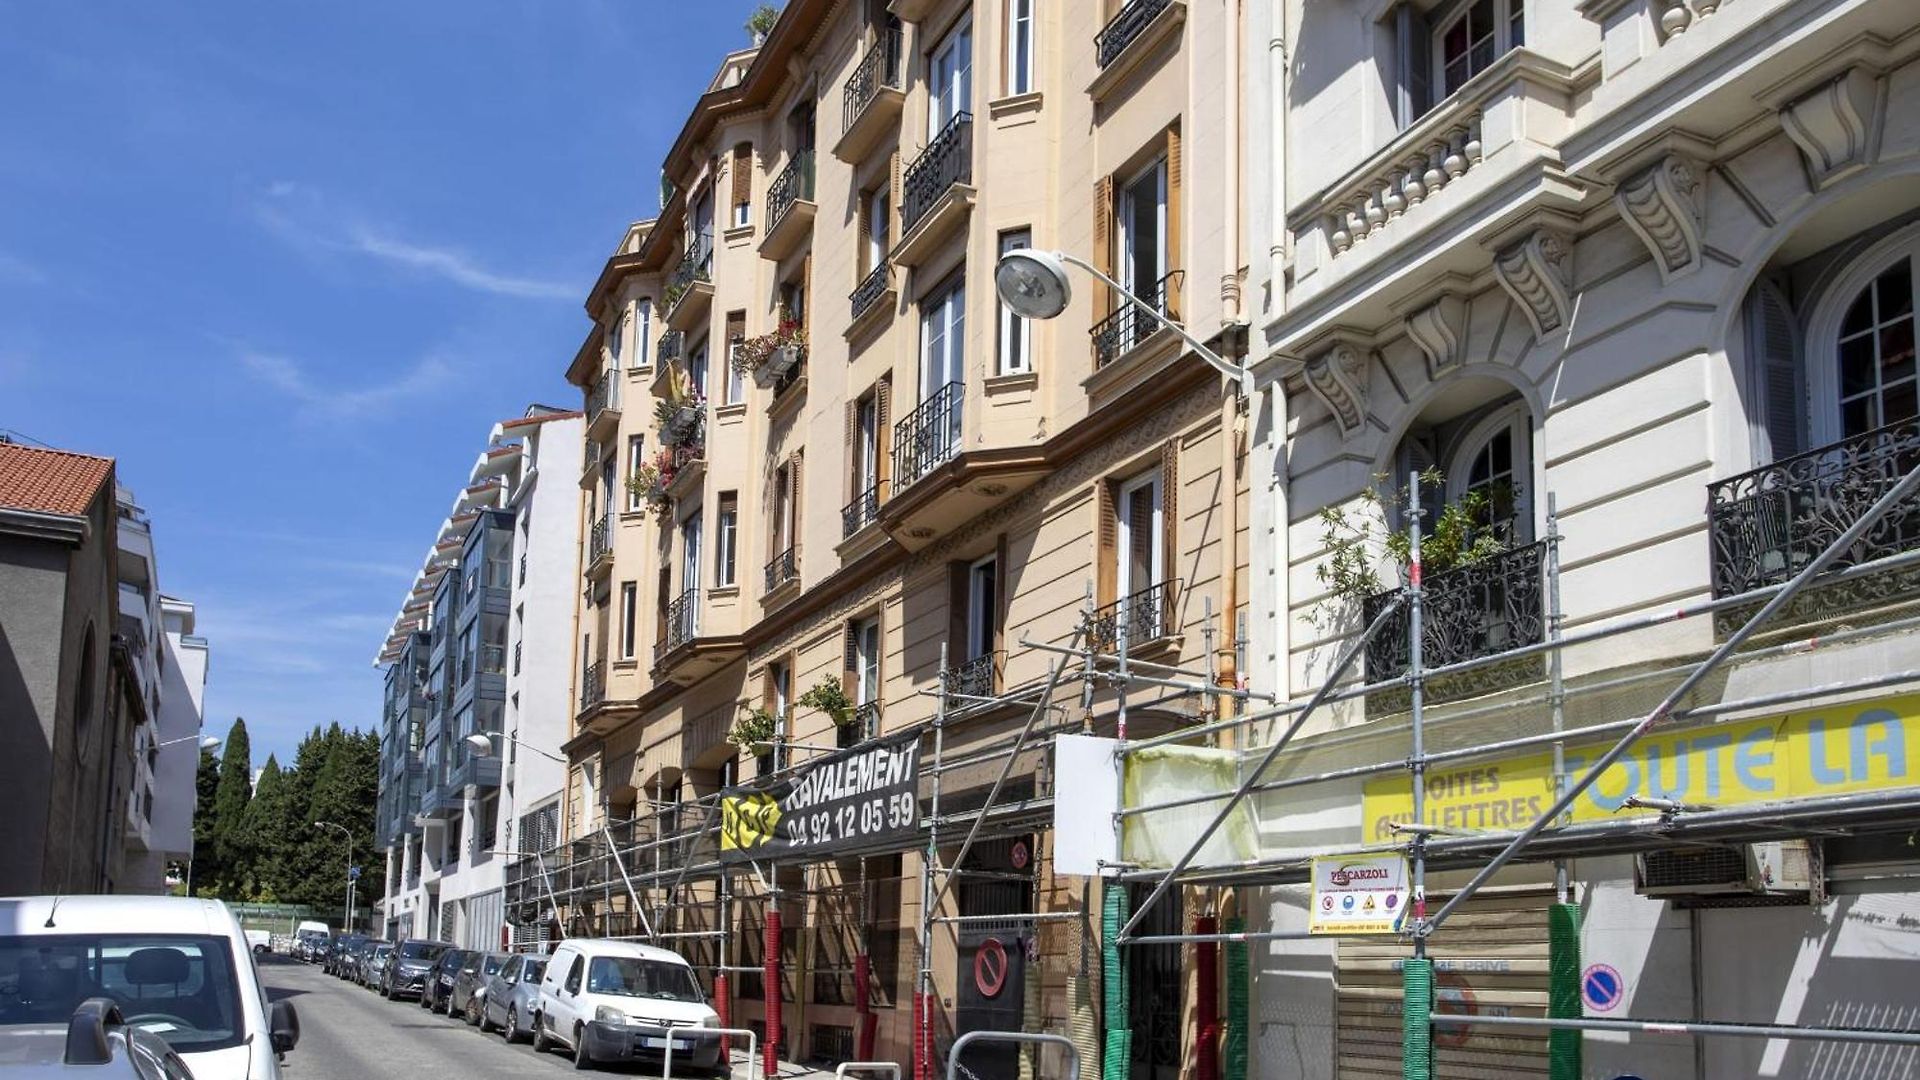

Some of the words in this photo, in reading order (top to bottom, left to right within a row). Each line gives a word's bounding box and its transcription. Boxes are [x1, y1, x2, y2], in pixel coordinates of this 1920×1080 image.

[1421, 767, 1500, 800] OITES
[1560, 726, 1775, 815] TOUTE
[1808, 708, 1906, 785] LA
[787, 816, 808, 847] 04
[811, 811, 831, 844] 92
[835, 805, 855, 838] 12
[861, 799, 883, 834] 05
[888, 792, 914, 829] 59
[1331, 869, 1388, 881] PESCARZOLI
